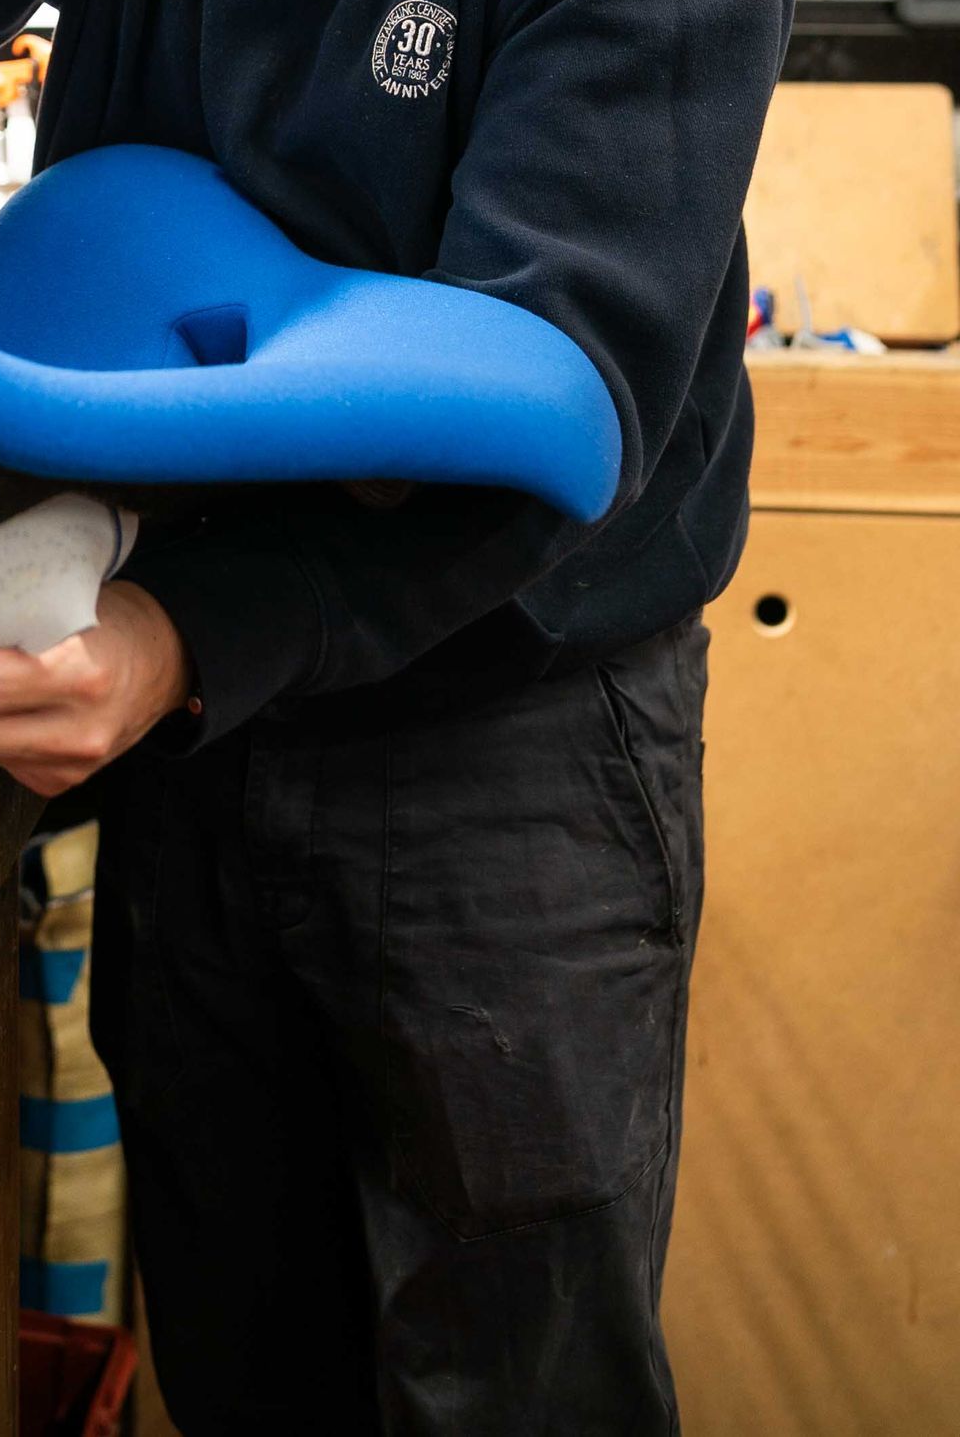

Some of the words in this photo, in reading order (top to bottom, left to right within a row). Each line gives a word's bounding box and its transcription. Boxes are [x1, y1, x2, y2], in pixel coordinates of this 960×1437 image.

[384, 3, 415, 37] ANGLING
[417, 3, 452, 27] CENTRE
[397, 19, 436, 56] 30
[380, 33, 455, 98] ANNIVERSARY
[391, 65, 406, 78] EST
[408, 69, 428, 82] 1992
[393, 52, 430, 71] YEARS
